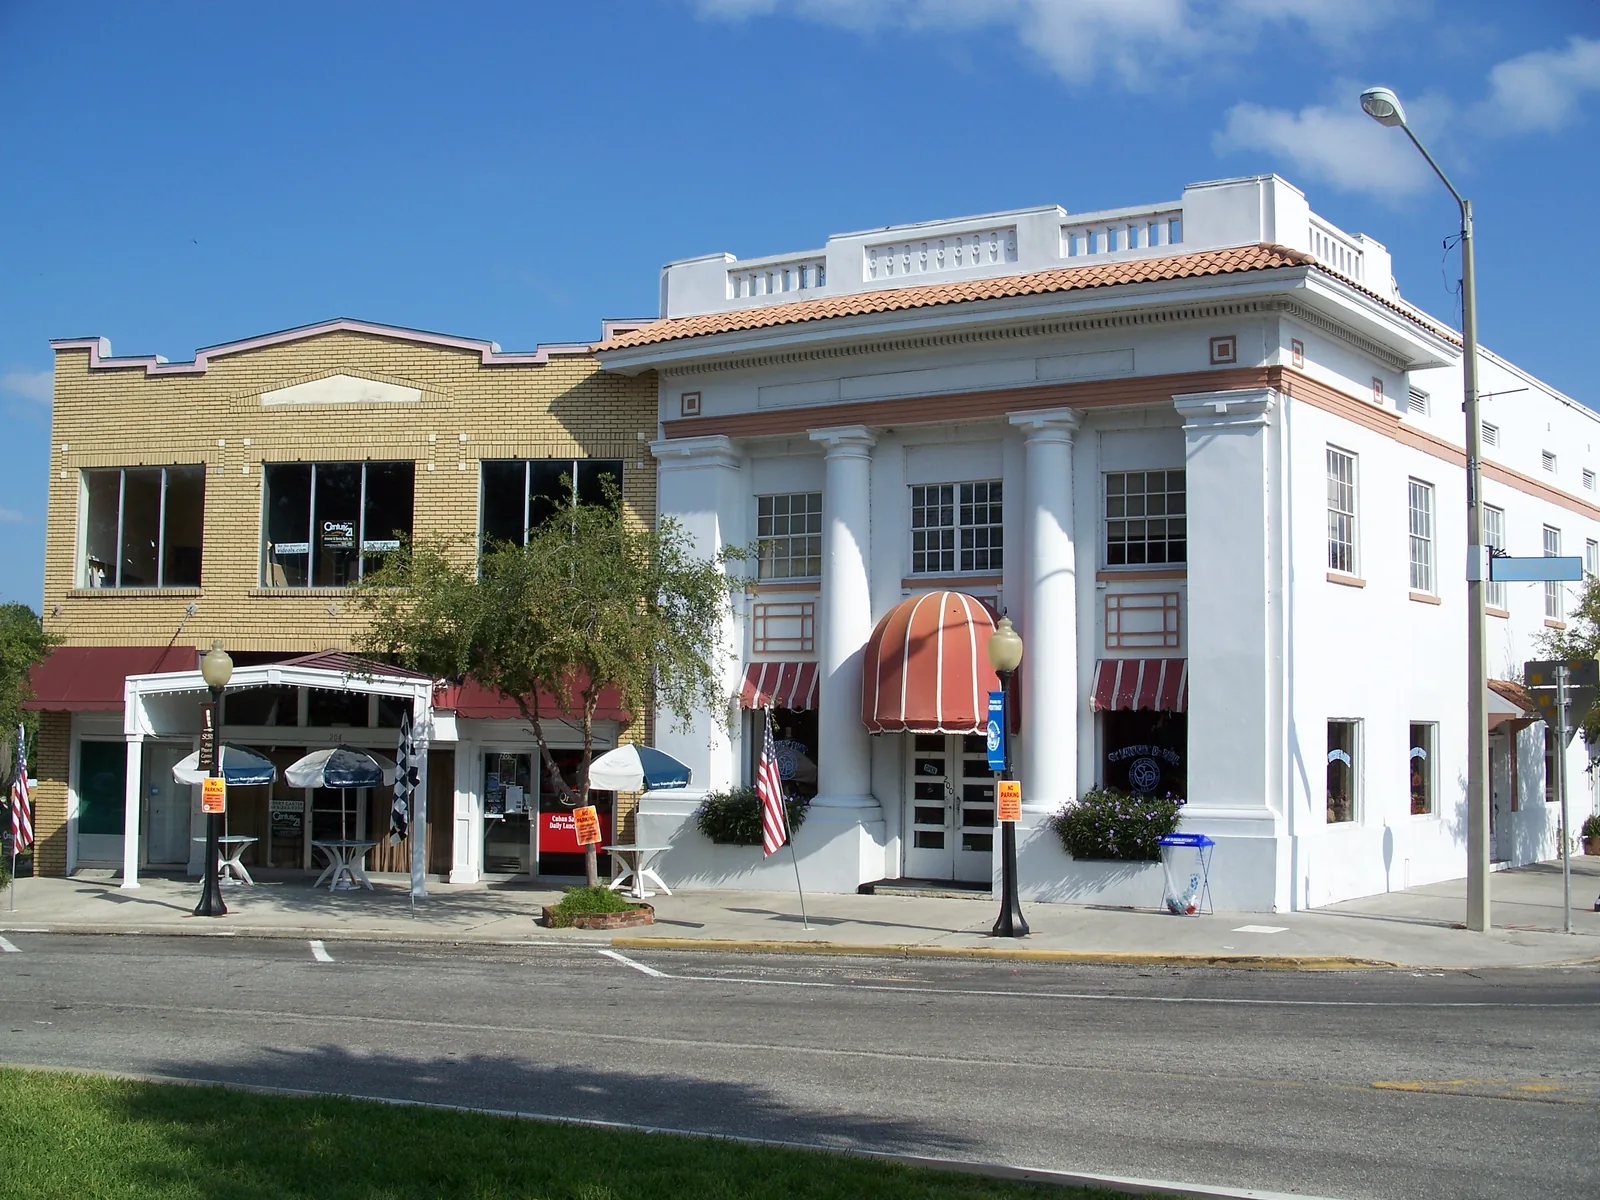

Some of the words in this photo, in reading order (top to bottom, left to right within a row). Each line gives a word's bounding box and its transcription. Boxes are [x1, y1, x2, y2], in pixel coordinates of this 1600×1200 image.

[324, 521, 348, 531] Century
[345, 527, 353, 536] 21
[943, 776, 953, 795] 200
[272, 811, 296, 821] Century
[576, 815, 596, 823] PARKING
[293, 817, 300, 826] 21
[549, 822, 562, 830] Daily
